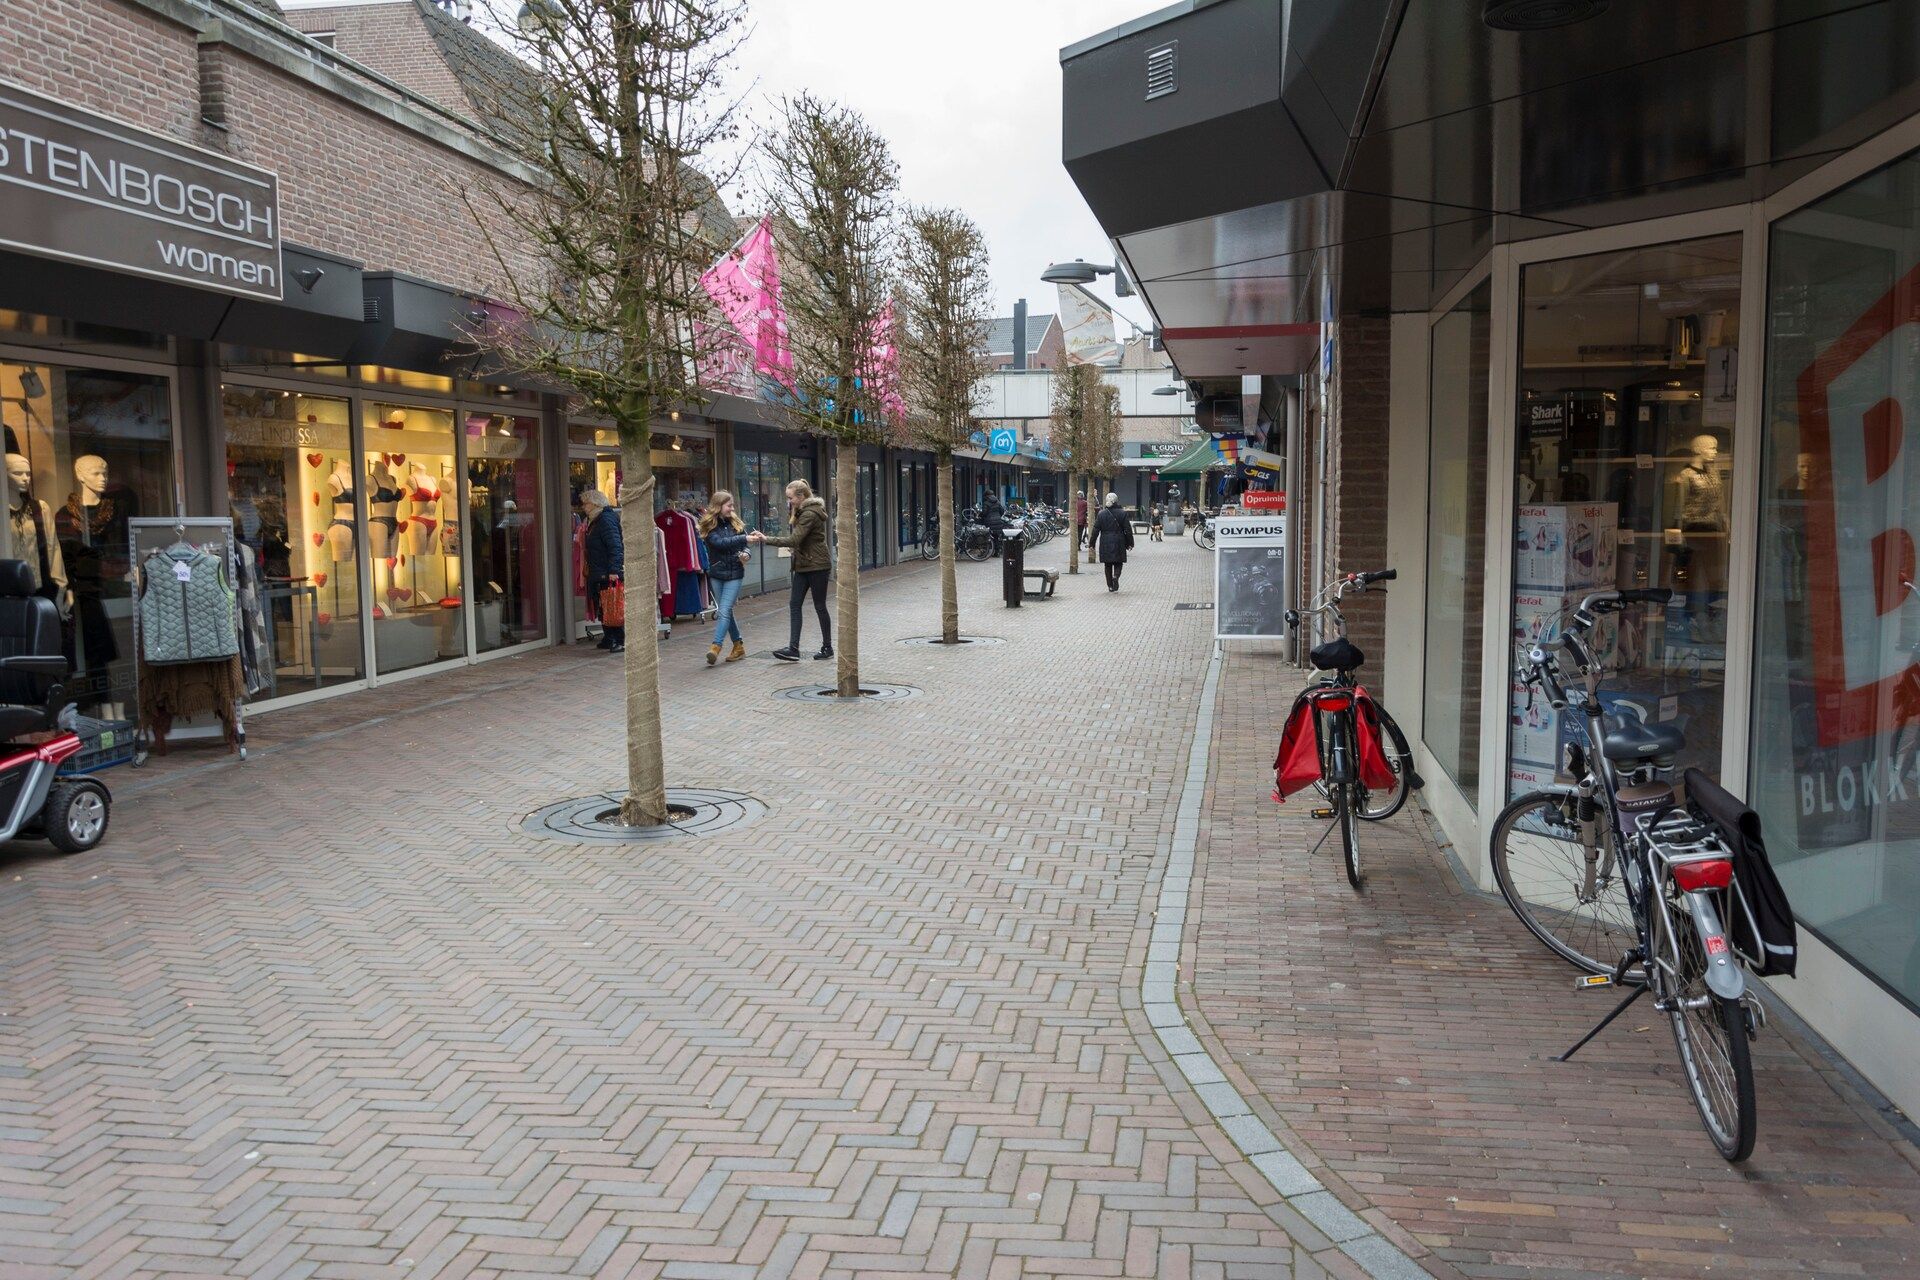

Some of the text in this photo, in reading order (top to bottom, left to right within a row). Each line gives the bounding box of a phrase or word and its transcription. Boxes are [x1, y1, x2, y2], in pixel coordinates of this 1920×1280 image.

[0, 126, 272, 239] TENBOSCH
[157, 240, 275, 288] women
[1531, 404, 1563, 419] Shark
[1159, 444, 1184, 452] GUSTO
[1257, 471, 1270, 480] GLS
[1246, 494, 1286, 504] Opruimin
[1583, 506, 1604, 518] Tefal
[1220, 526, 1283, 535] OLYMPUS
[1800, 751, 1920, 816] BLOKK
